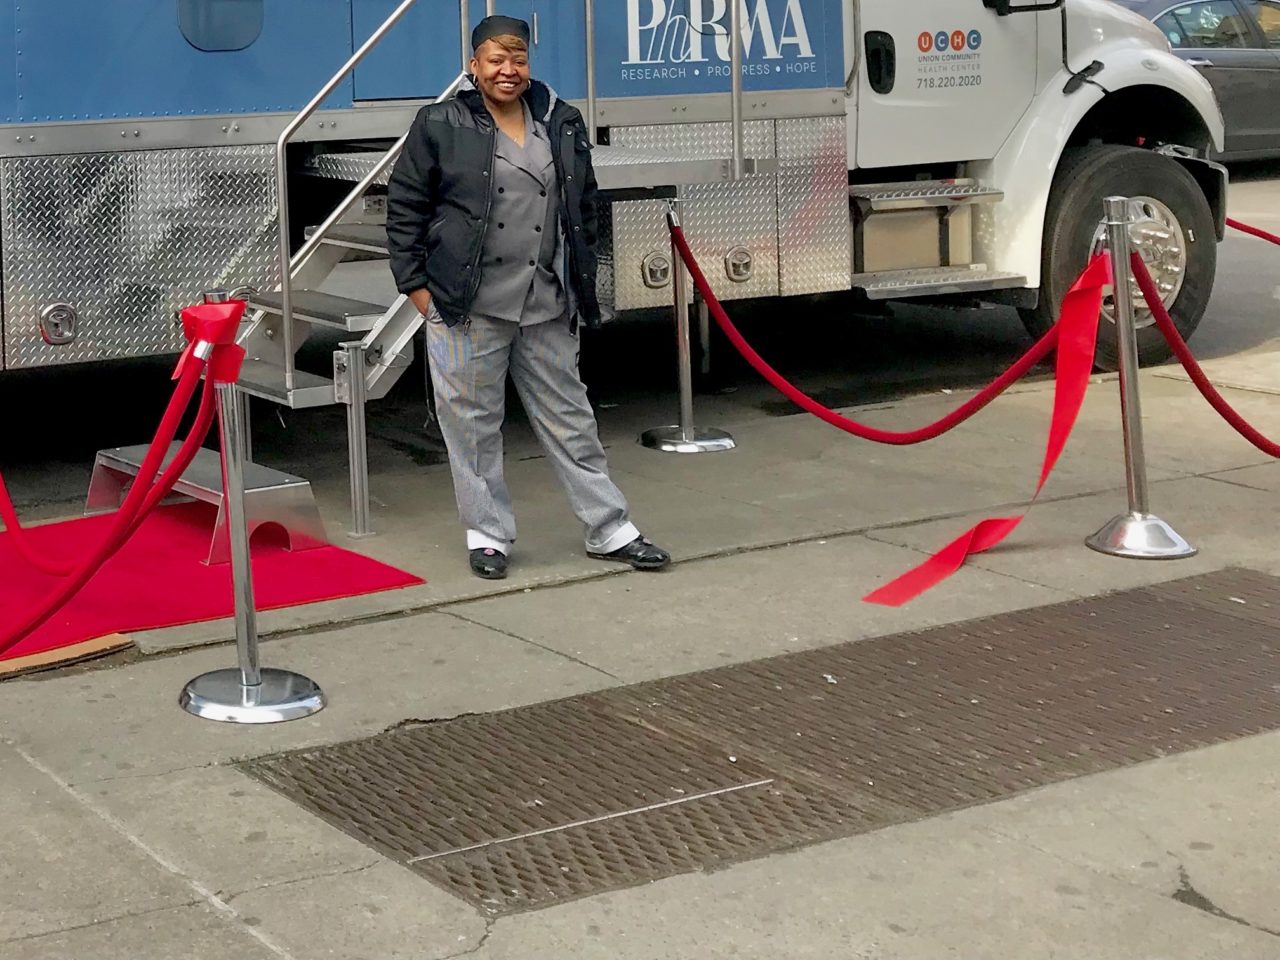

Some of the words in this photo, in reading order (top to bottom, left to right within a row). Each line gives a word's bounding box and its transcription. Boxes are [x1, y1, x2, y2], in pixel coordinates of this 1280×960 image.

[918, 55, 940, 63] UNION
[941, 53, 980, 62] COMMUNITY
[621, 67, 687, 80] RESEARCH
[707, 64, 770, 77] PRORESS
[786, 62, 817, 73] HOPE
[918, 65, 948, 73] HEALTH
[951, 63, 981, 71] CENTER
[917, 74, 982, 88] 718.220.2020
